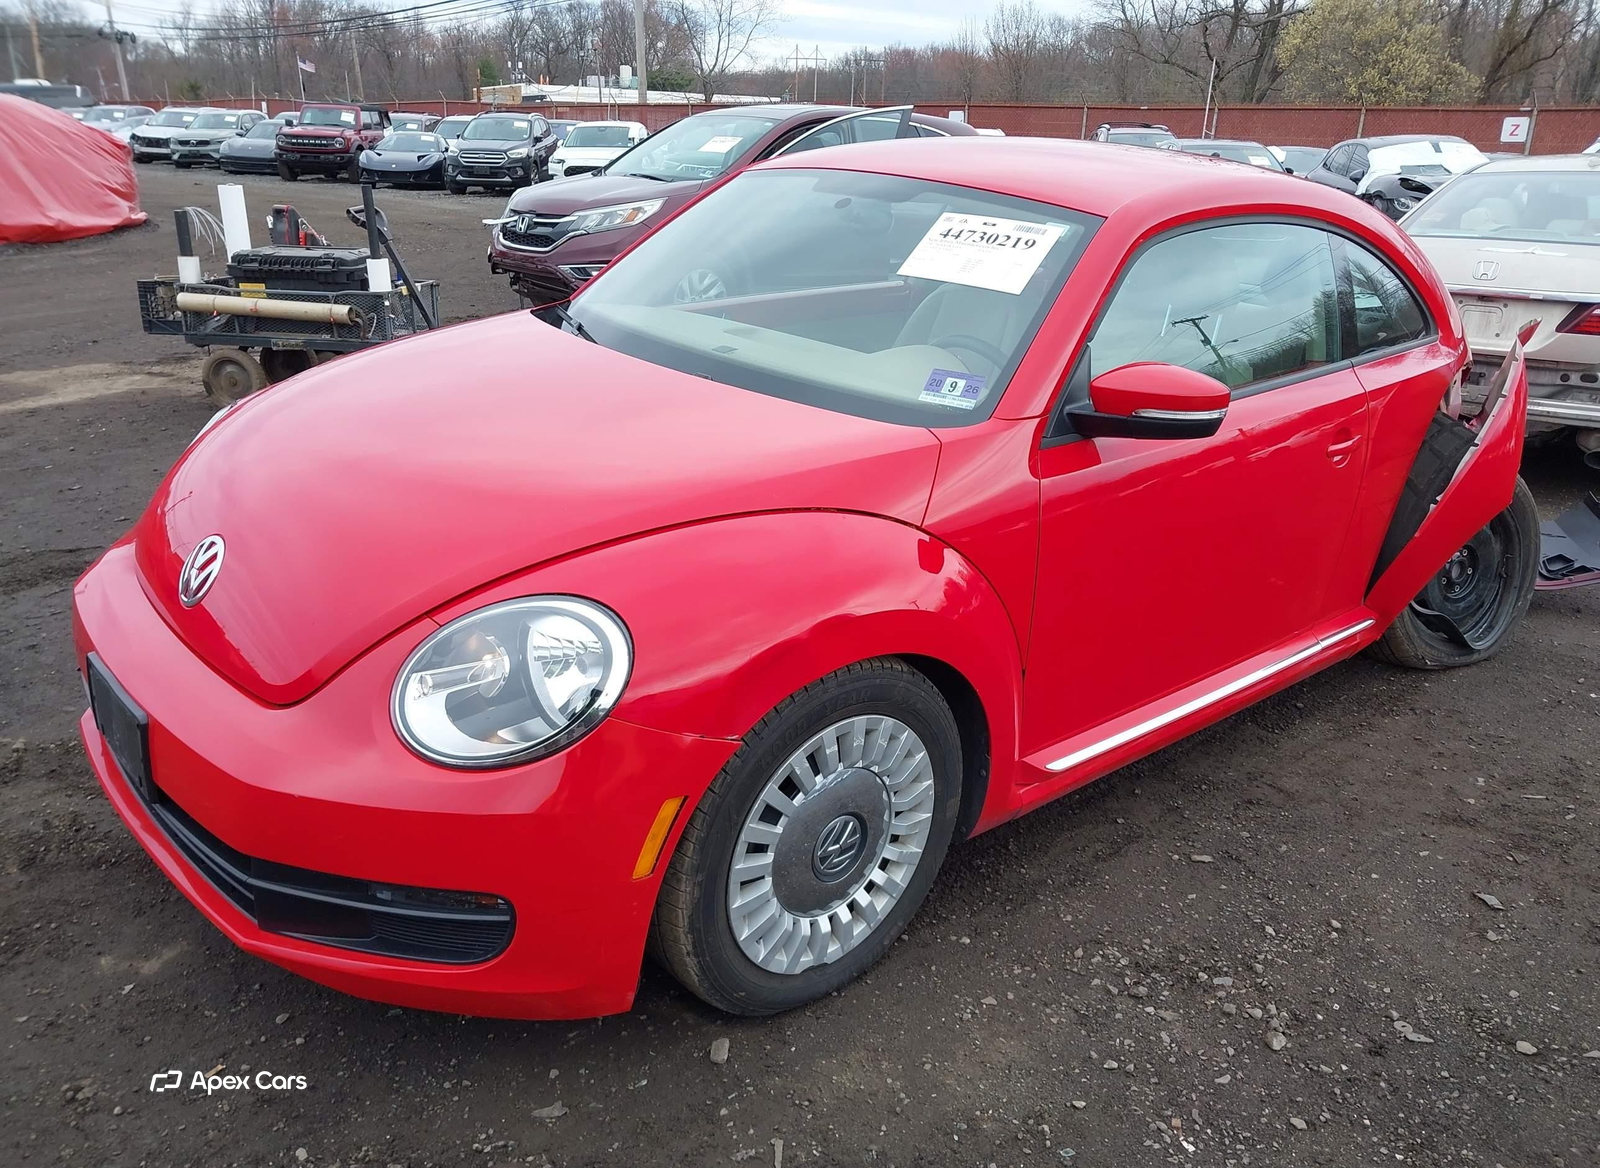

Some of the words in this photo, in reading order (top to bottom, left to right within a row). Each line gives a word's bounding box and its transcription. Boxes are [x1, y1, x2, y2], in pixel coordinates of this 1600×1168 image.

[1509, 124, 1520, 136] Z
[939, 227, 1037, 250] 44730219
[929, 378, 943, 388] 20
[948, 380, 958, 393] 9
[964, 384, 980, 394] 26
